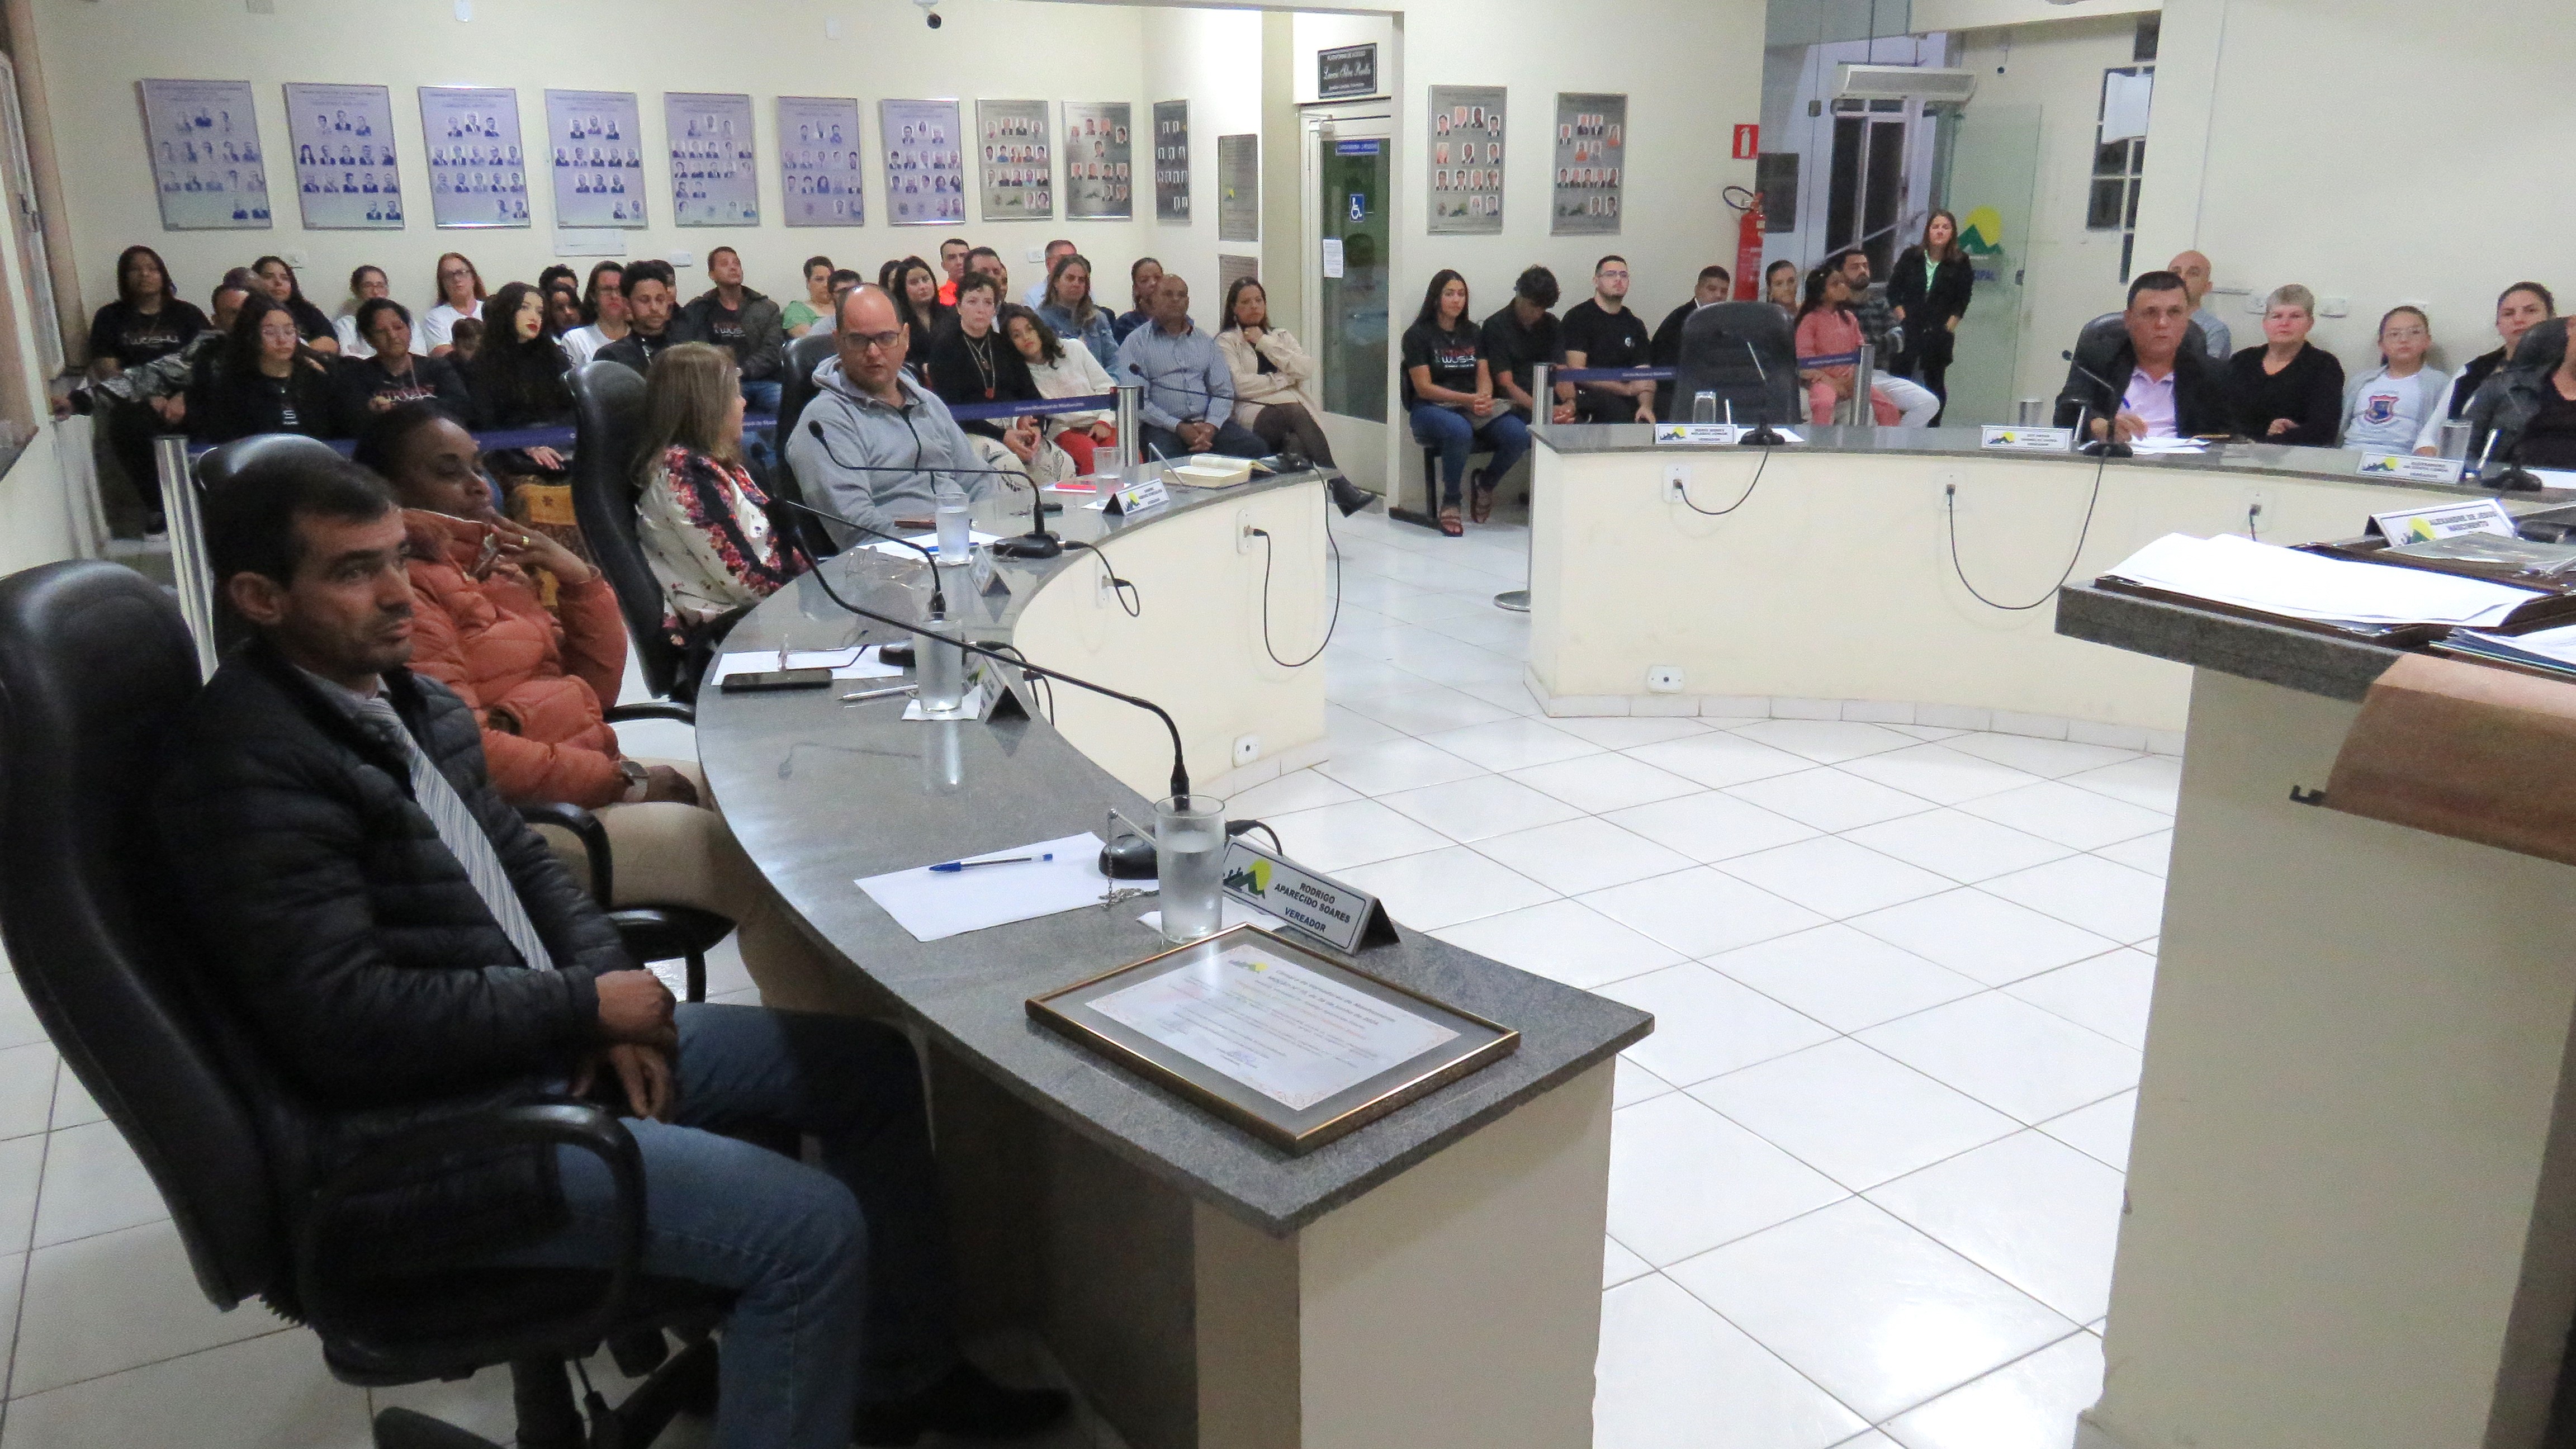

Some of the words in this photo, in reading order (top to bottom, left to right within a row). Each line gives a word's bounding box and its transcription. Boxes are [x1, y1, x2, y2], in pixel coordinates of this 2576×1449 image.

[1274, 883, 1318, 908] APARECIDO
[1319, 903, 1351, 924] SOARES
[1300, 883, 1336, 905] RODRIGO
[1285, 907, 1327, 932] VEREADOR
